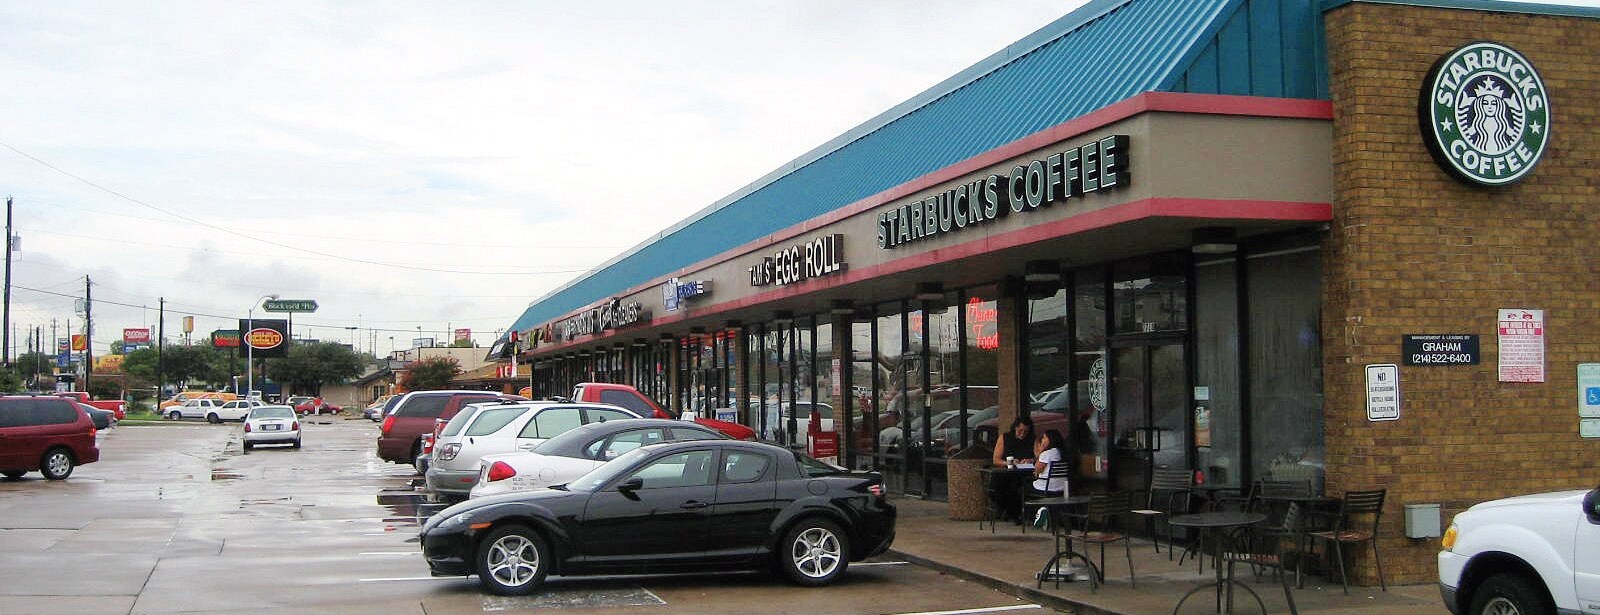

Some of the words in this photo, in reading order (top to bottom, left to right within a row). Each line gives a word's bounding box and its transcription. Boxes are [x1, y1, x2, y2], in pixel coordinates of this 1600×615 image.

[1437, 50, 1542, 111] STARBUCKS
[1450, 139, 1533, 176] COFFEE
[876, 174, 998, 249] STARBUCKS
[1008, 135, 1117, 213] COFFEE
[775, 246, 800, 286] EGG
[806, 234, 840, 278] ROLL
[1422, 342, 1461, 352] GRAHAM
[1377, 372, 1386, 382] NO
